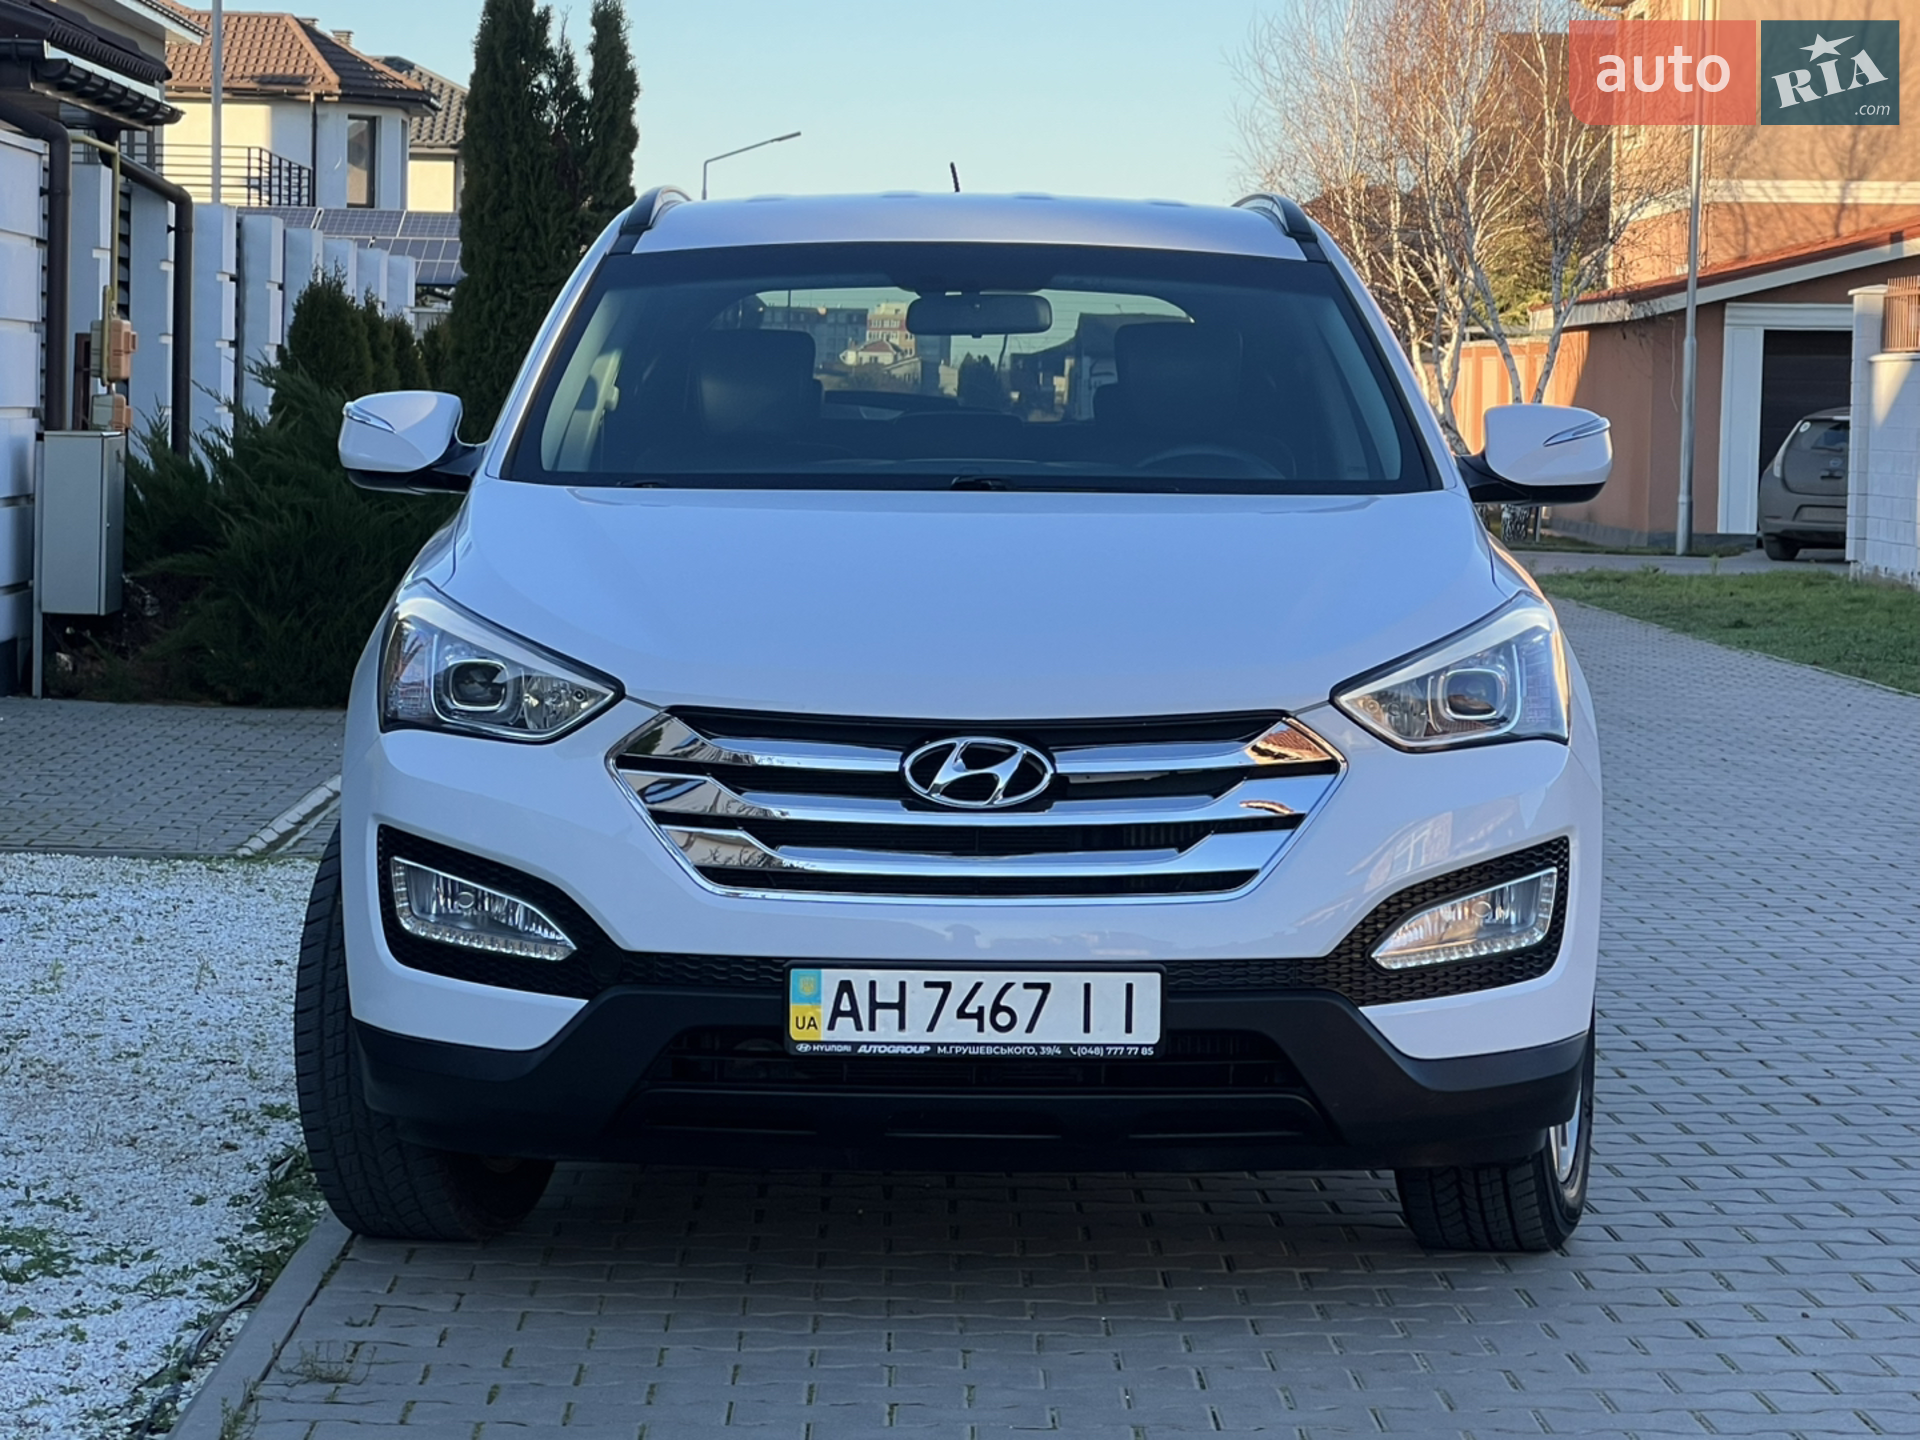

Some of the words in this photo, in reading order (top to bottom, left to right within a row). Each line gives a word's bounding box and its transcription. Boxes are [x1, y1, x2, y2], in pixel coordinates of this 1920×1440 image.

[923, 981, 1052, 1034] 7467
[795, 1016, 818, 1030] UA
[857, 1045, 931, 1054] AUTOGROUP
[1077, 1046, 1104, 1057] (048)
[1106, 1047, 1124, 1056] 777
[1126, 1047, 1140, 1056] 77
